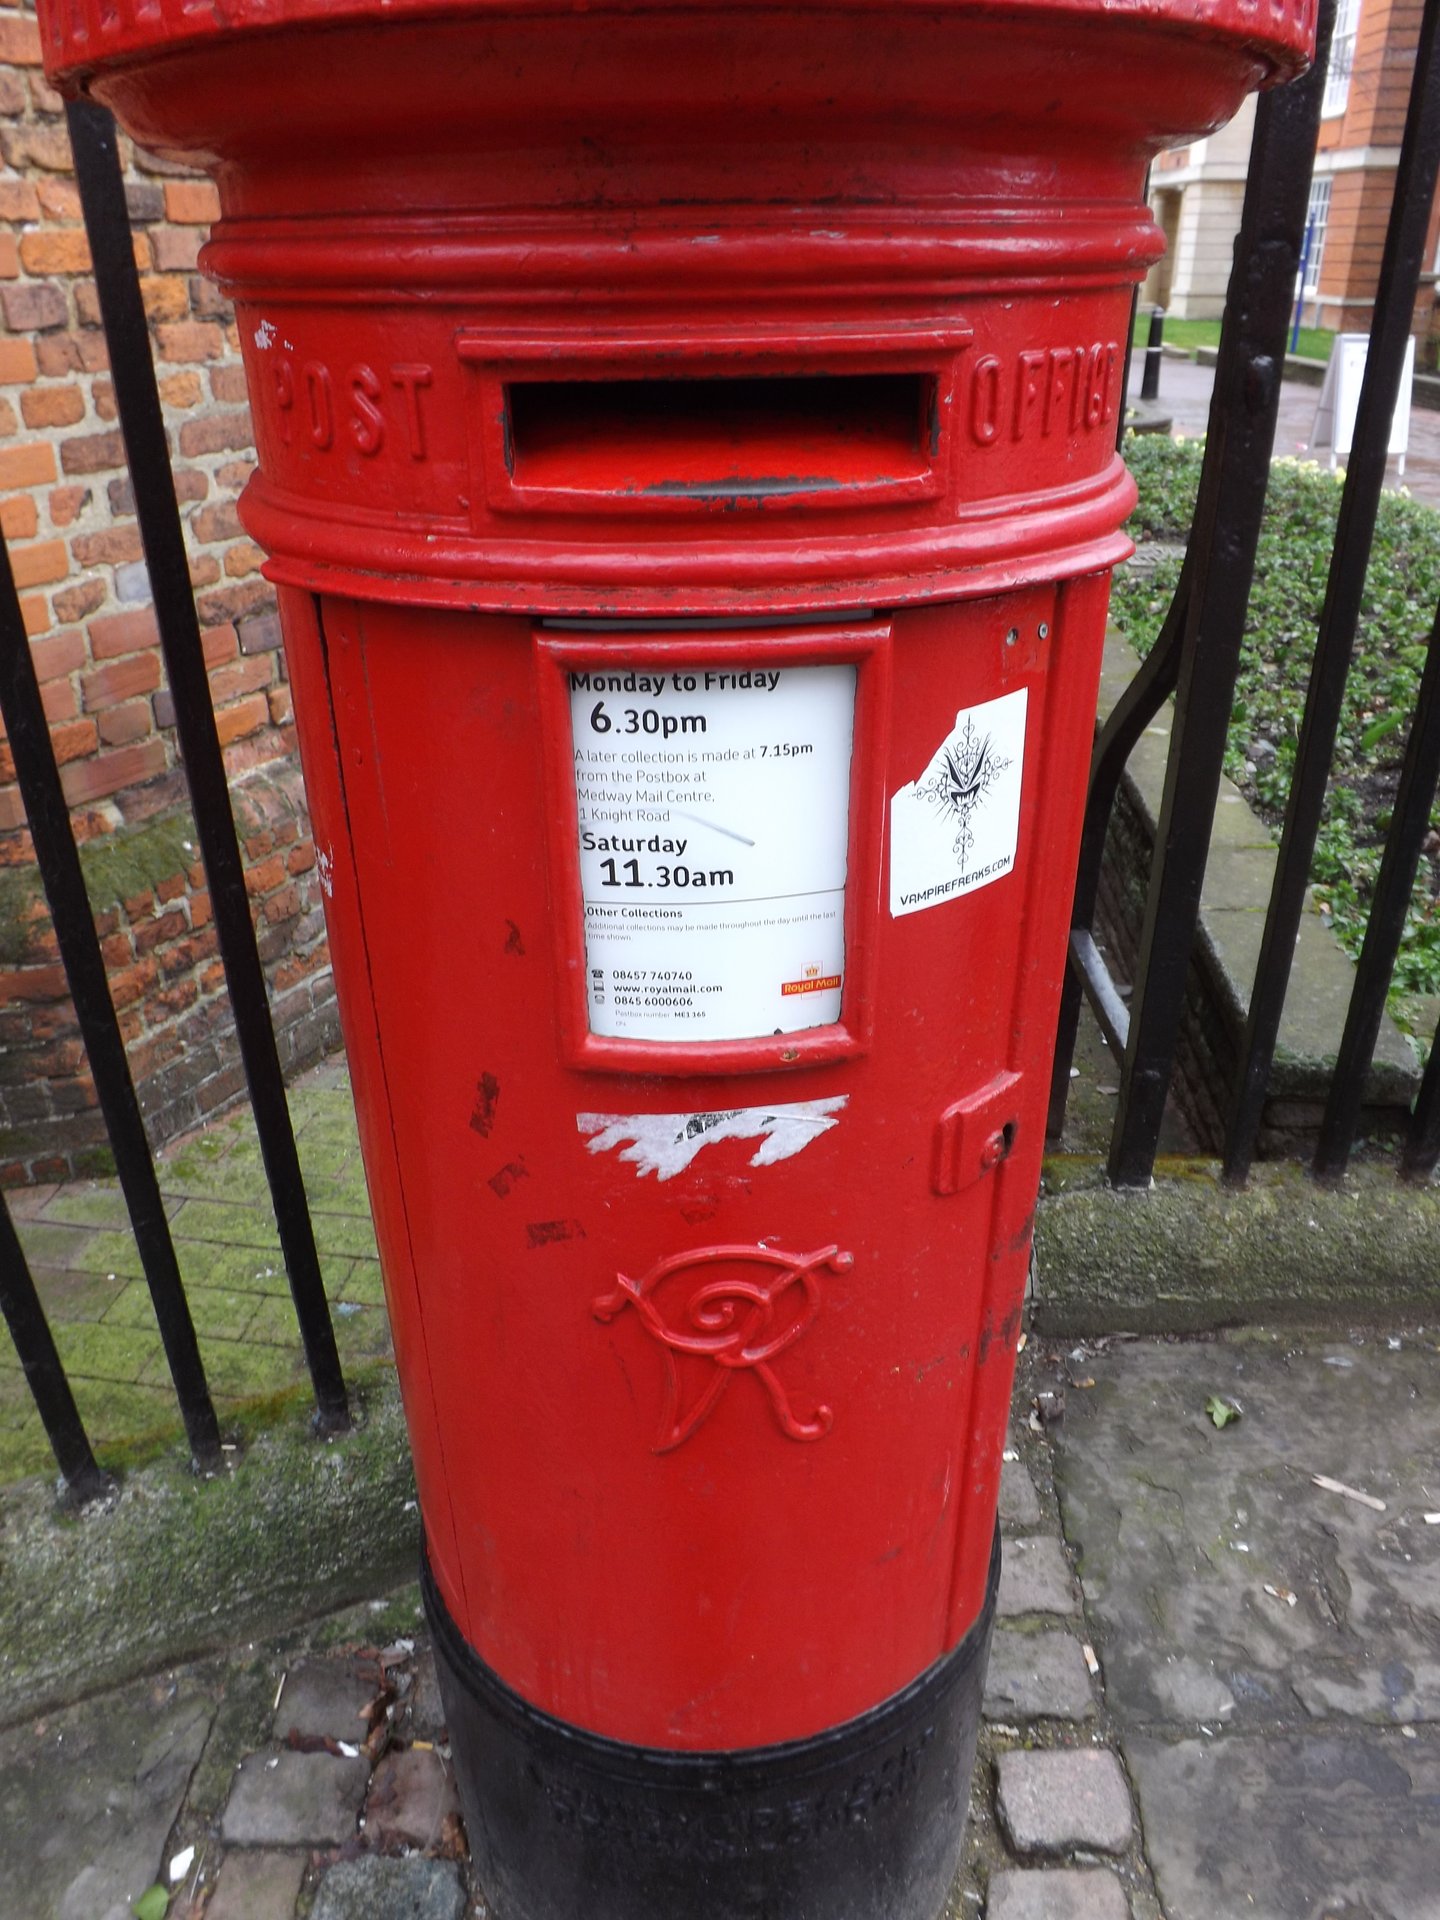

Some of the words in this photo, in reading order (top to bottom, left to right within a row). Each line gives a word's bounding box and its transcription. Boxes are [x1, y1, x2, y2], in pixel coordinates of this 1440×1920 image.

[271, 357, 432, 461] POST
[571, 672, 665, 696] Monday
[673, 673, 697, 691] to
[704, 671, 781, 691] Friday
[590, 701, 707, 739] 6.30pm
[575, 750, 585, 761] A
[587, 750, 617, 762] later
[621, 751, 684, 763] collection
[688, 750, 698, 762] is
[701, 749, 739, 762] made
[743, 749, 755, 760] at
[760, 743, 813, 758] 7.15pm
[576, 770, 608, 782] from
[611, 770, 633, 783] the
[637, 770, 690, 783] Postbox
[693, 771, 707, 782] at
[578, 789, 632, 804] Medway
[636, 790, 663, 803] Mail
[667, 789, 715, 803] Centre,
[580, 808, 587, 820] 1
[591, 808, 633, 824] Knight
[636, 809, 670, 822] Road
[582, 832, 688, 856] Saturday
[600, 858, 734, 888] 11.30am
[900, 855, 1011, 906] VAMPIREFREAKS.COM
[587, 907, 618, 917] Other
[621, 908, 683, 918] Collections
[588, 922, 625, 930] Additional
[626, 923, 665, 932] collections
[668, 924, 683, 932] may
[686, 923, 694, 931] be
[720, 920, 762, 931] throughout
[764, 917, 775, 926] the
[777, 916, 790, 926] day
[792, 913, 809, 922] until
[810, 912, 821, 920] the
[823, 911, 836, 919] last
[613, 970, 647, 980] 08457
[650, 971, 692, 981] 740740
[613, 984, 723, 995] www.royalmail.com
[785, 980, 814, 993] Royal
[816, 977, 838, 988] Mail
[614, 996, 641, 1006] 0845
[645, 997, 693, 1006] 6000606
[615, 1010, 642, 1018] Postbox
